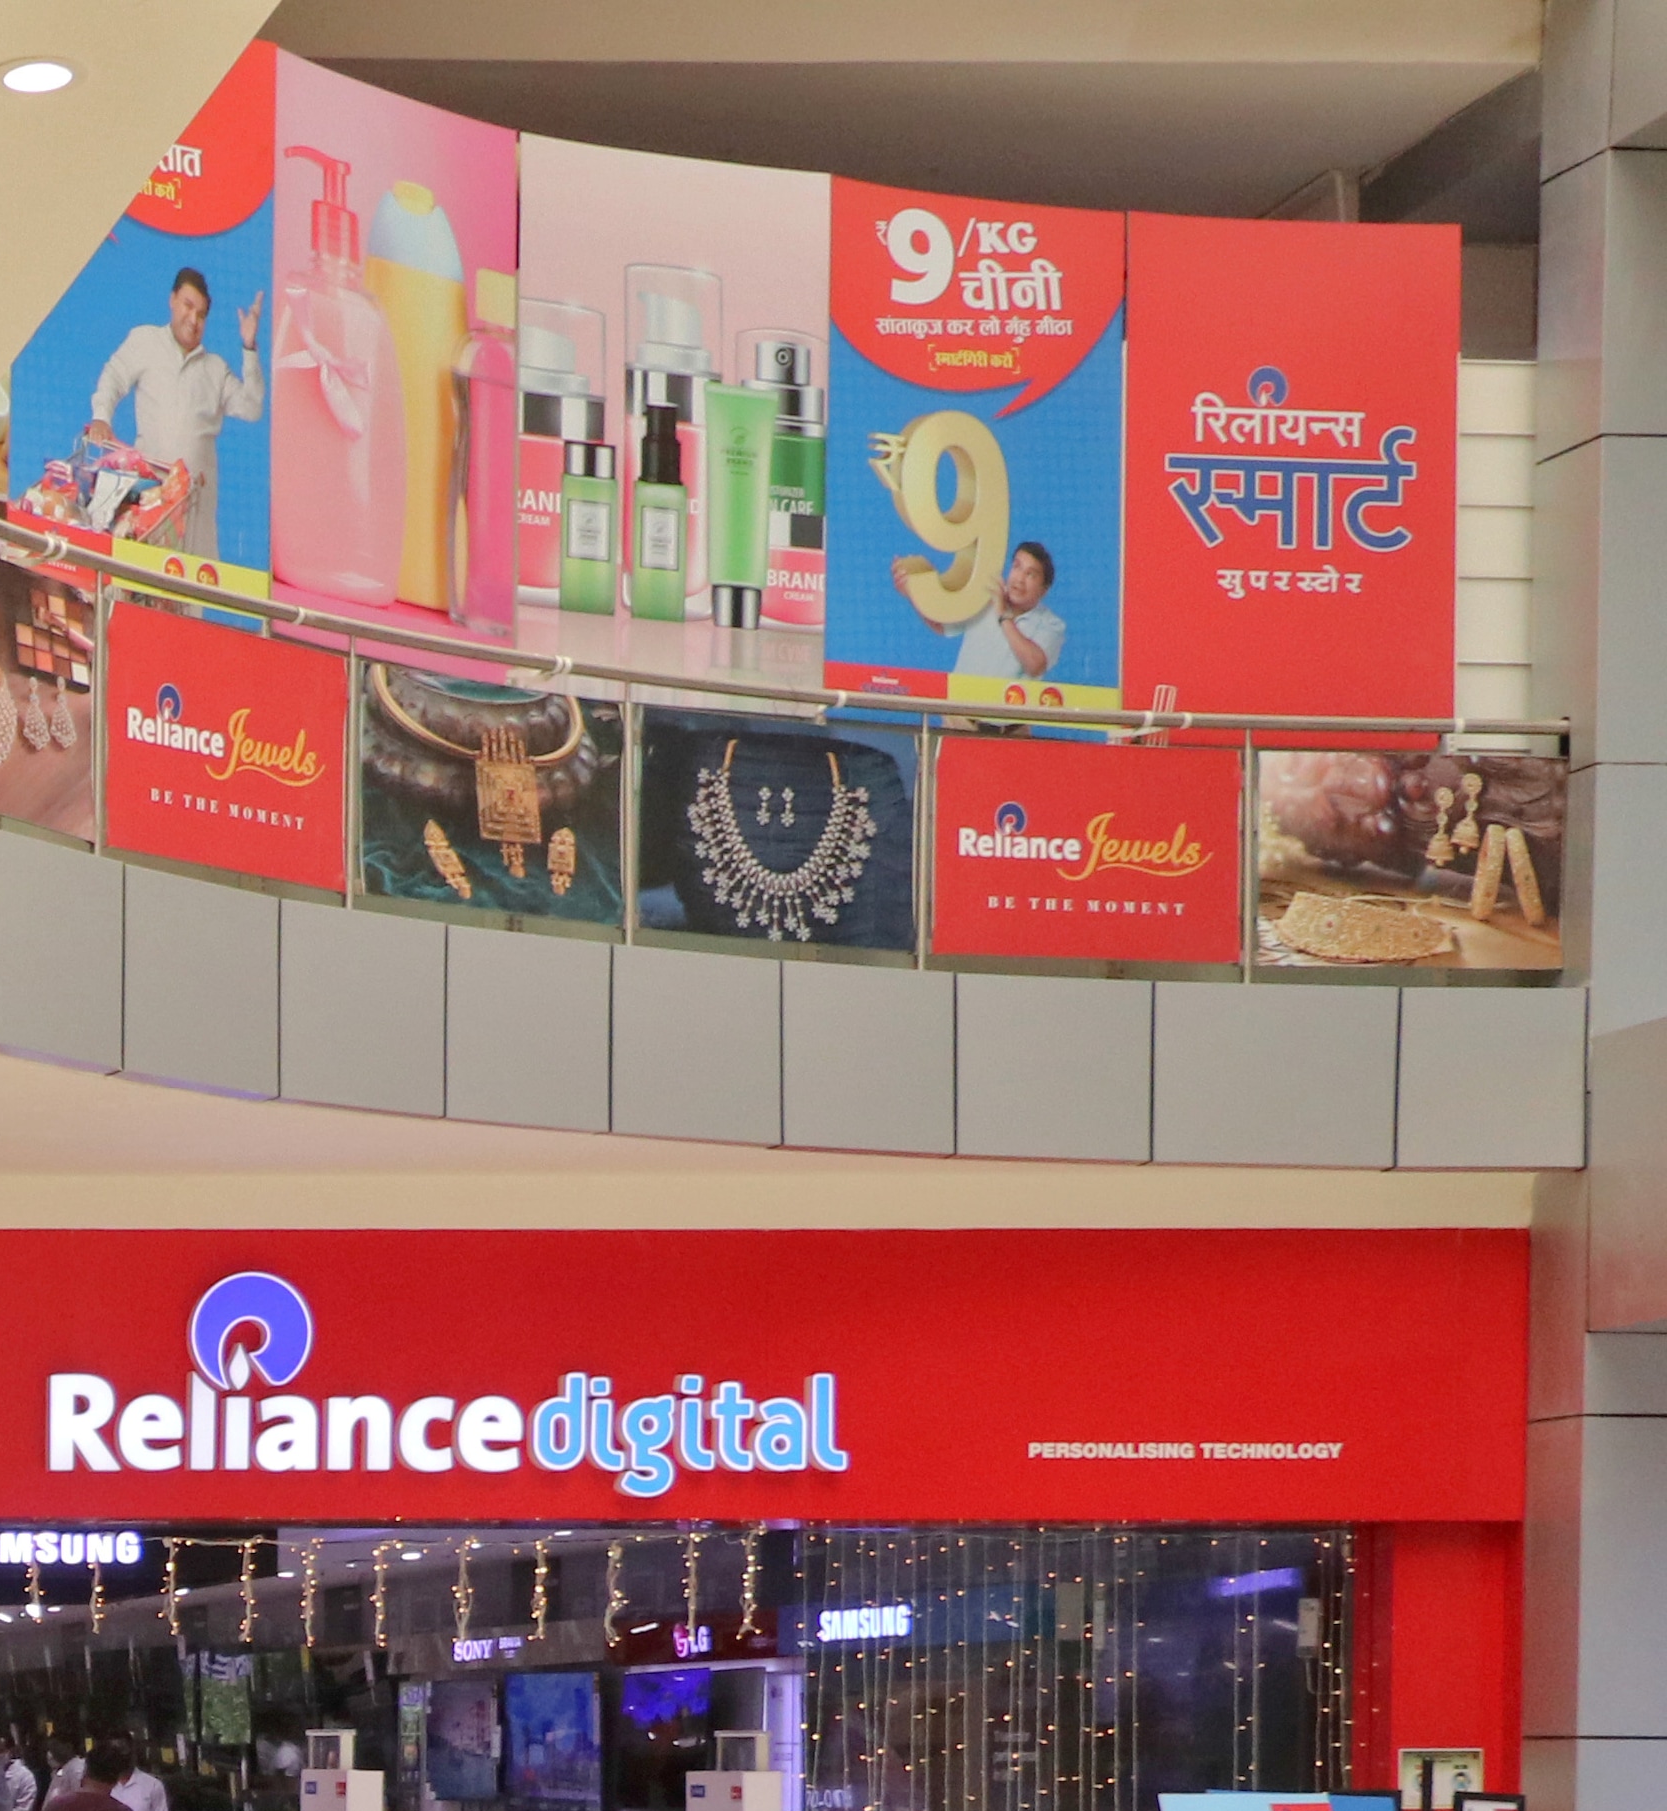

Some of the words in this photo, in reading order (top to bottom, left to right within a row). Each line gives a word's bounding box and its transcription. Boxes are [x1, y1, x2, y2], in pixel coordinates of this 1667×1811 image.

[958, 258, 1063, 311] चीनी
[1191, 391, 1366, 448] रिलायन्स
[1165, 425, 1418, 552] स्मार्ट
[126, 703, 226, 759] Reliance
[205, 708, 324, 785] Jewels
[150, 788, 173, 805] BE
[183, 794, 220, 814] THE
[229, 803, 306, 831] MOMENT
[958, 825, 1082, 861] Reliance
[1056, 812, 1211, 881] Jewels
[987, 896, 1016, 910] BE
[1029, 897, 1074, 912] THE
[1087, 899, 1186, 916] MOMENT
[46, 1366, 525, 1474] Reliance
[531, 1371, 849, 1499] digital
[1027, 1442, 1195, 1459] PERSONALISING
[1199, 1442, 1344, 1460] TECHNOLOGY
[817, 1603, 913, 1643] SAMSUNG
[453, 1638, 493, 1662] SONY
